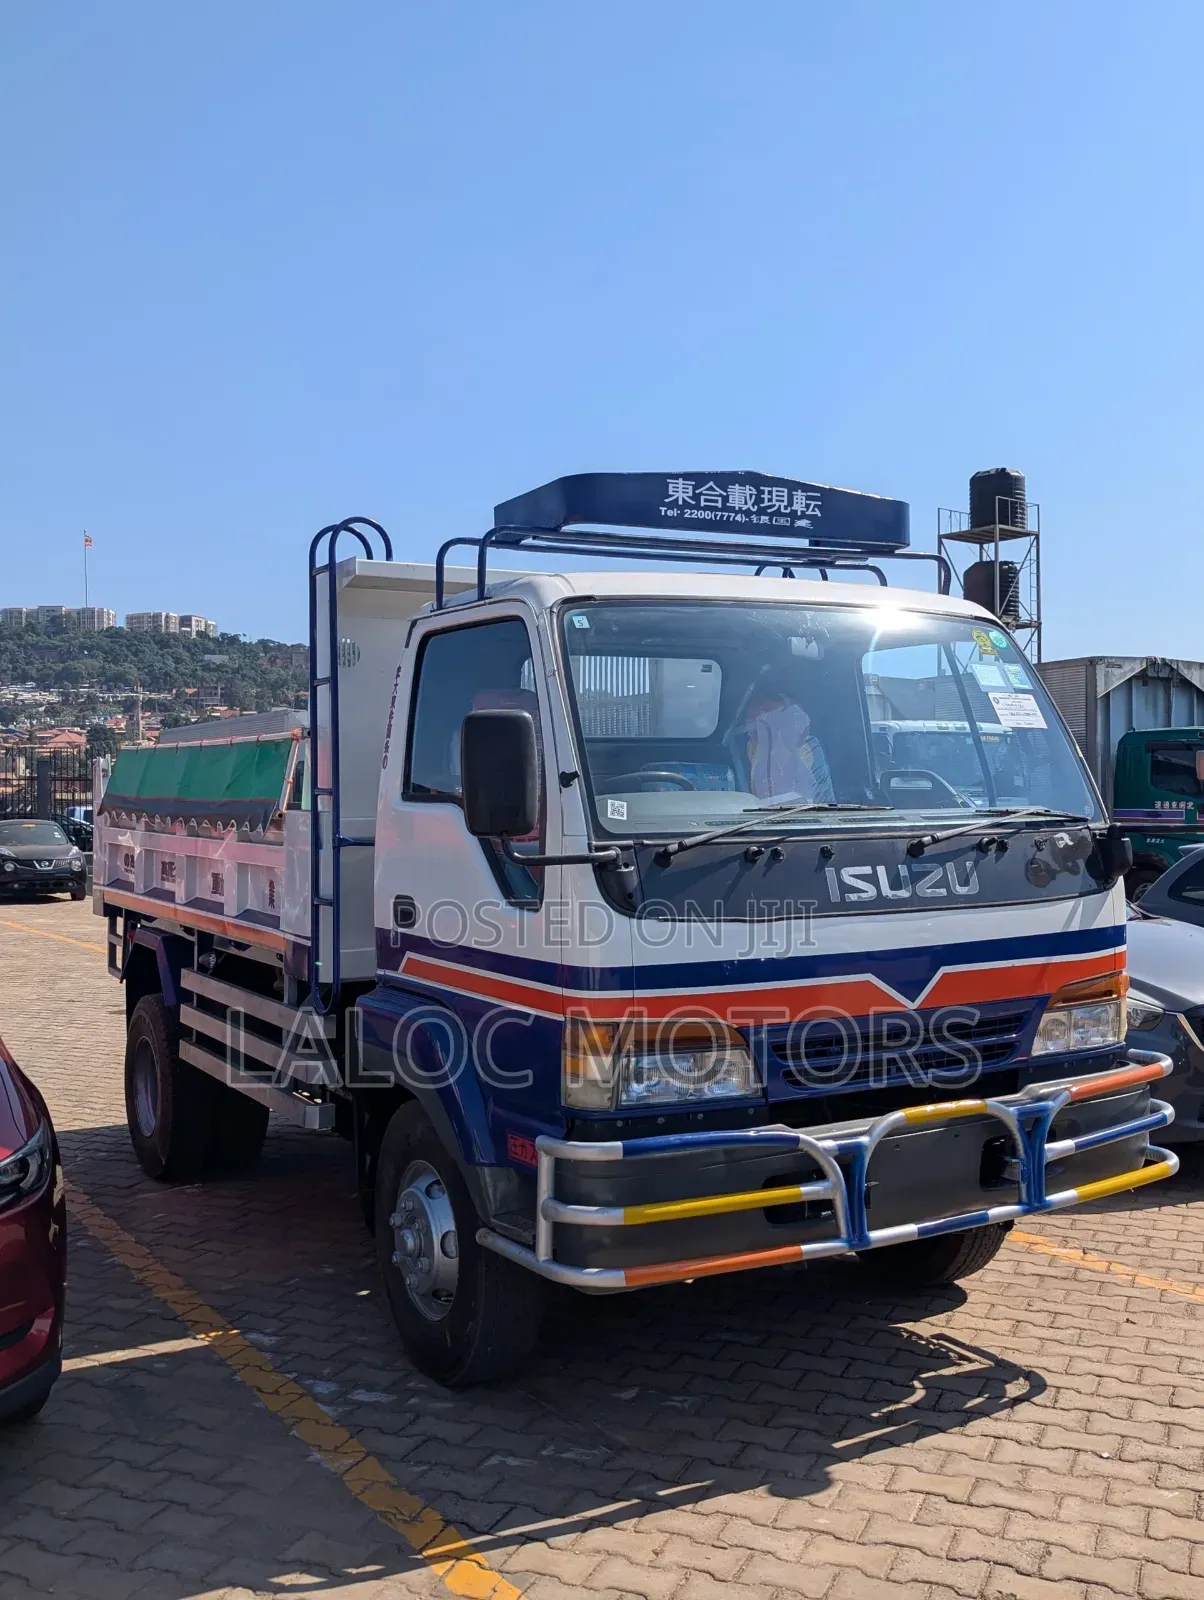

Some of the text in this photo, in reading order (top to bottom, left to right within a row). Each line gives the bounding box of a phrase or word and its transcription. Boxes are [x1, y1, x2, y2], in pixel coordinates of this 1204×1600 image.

[664, 477, 822, 517] 東合載現転
[824, 861, 980, 903] ISUZU
